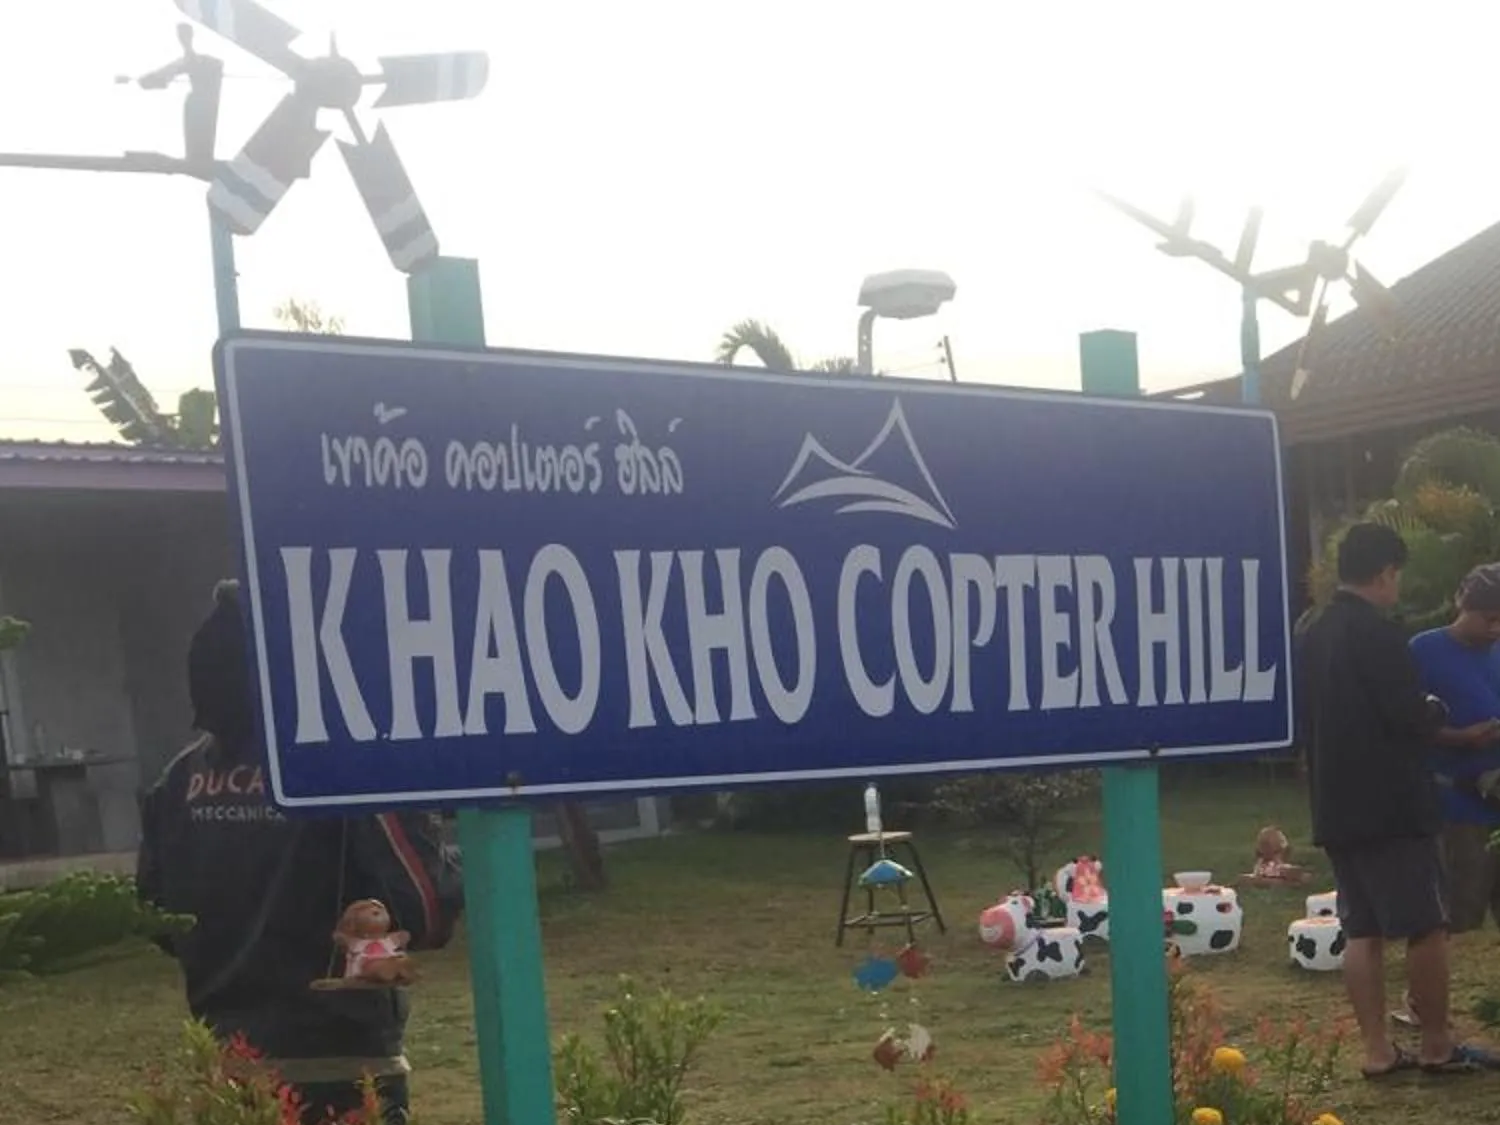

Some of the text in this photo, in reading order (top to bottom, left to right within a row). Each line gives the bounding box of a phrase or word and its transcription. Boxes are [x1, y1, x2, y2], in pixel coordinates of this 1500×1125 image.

[321, 402, 428, 488] เขาค้อ
[445, 416, 602, 494] คอปเตอร์
[280, 544, 1277, 744] KHAO KHO COPTER HILL
[186, 765, 266, 801] DUCA
